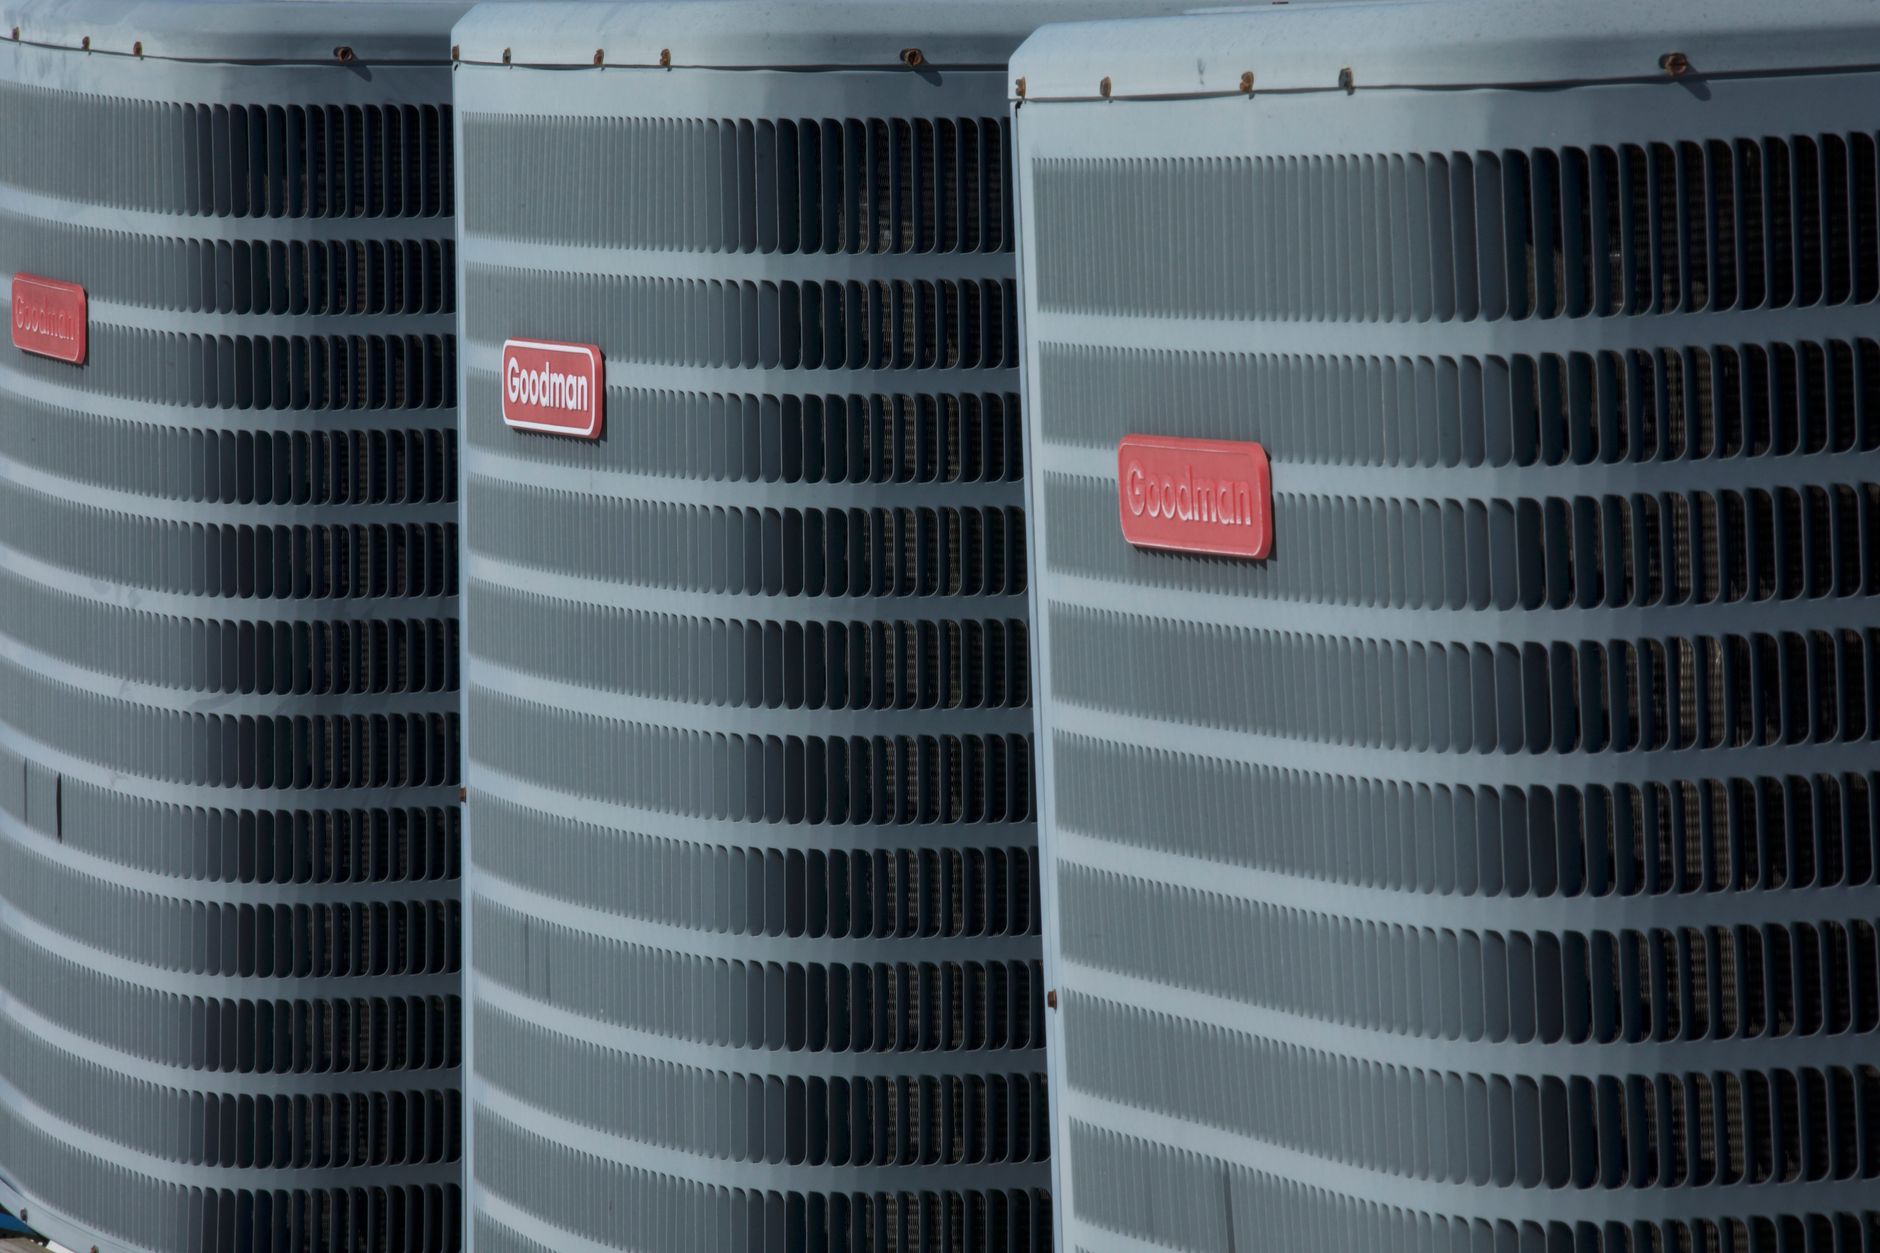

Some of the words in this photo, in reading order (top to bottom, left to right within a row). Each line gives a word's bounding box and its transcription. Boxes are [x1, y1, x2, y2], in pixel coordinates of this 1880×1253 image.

[15, 295, 74, 341] Goodman
[507, 356, 588, 411] Goodman
[1127, 462, 1253, 526] Goodman
